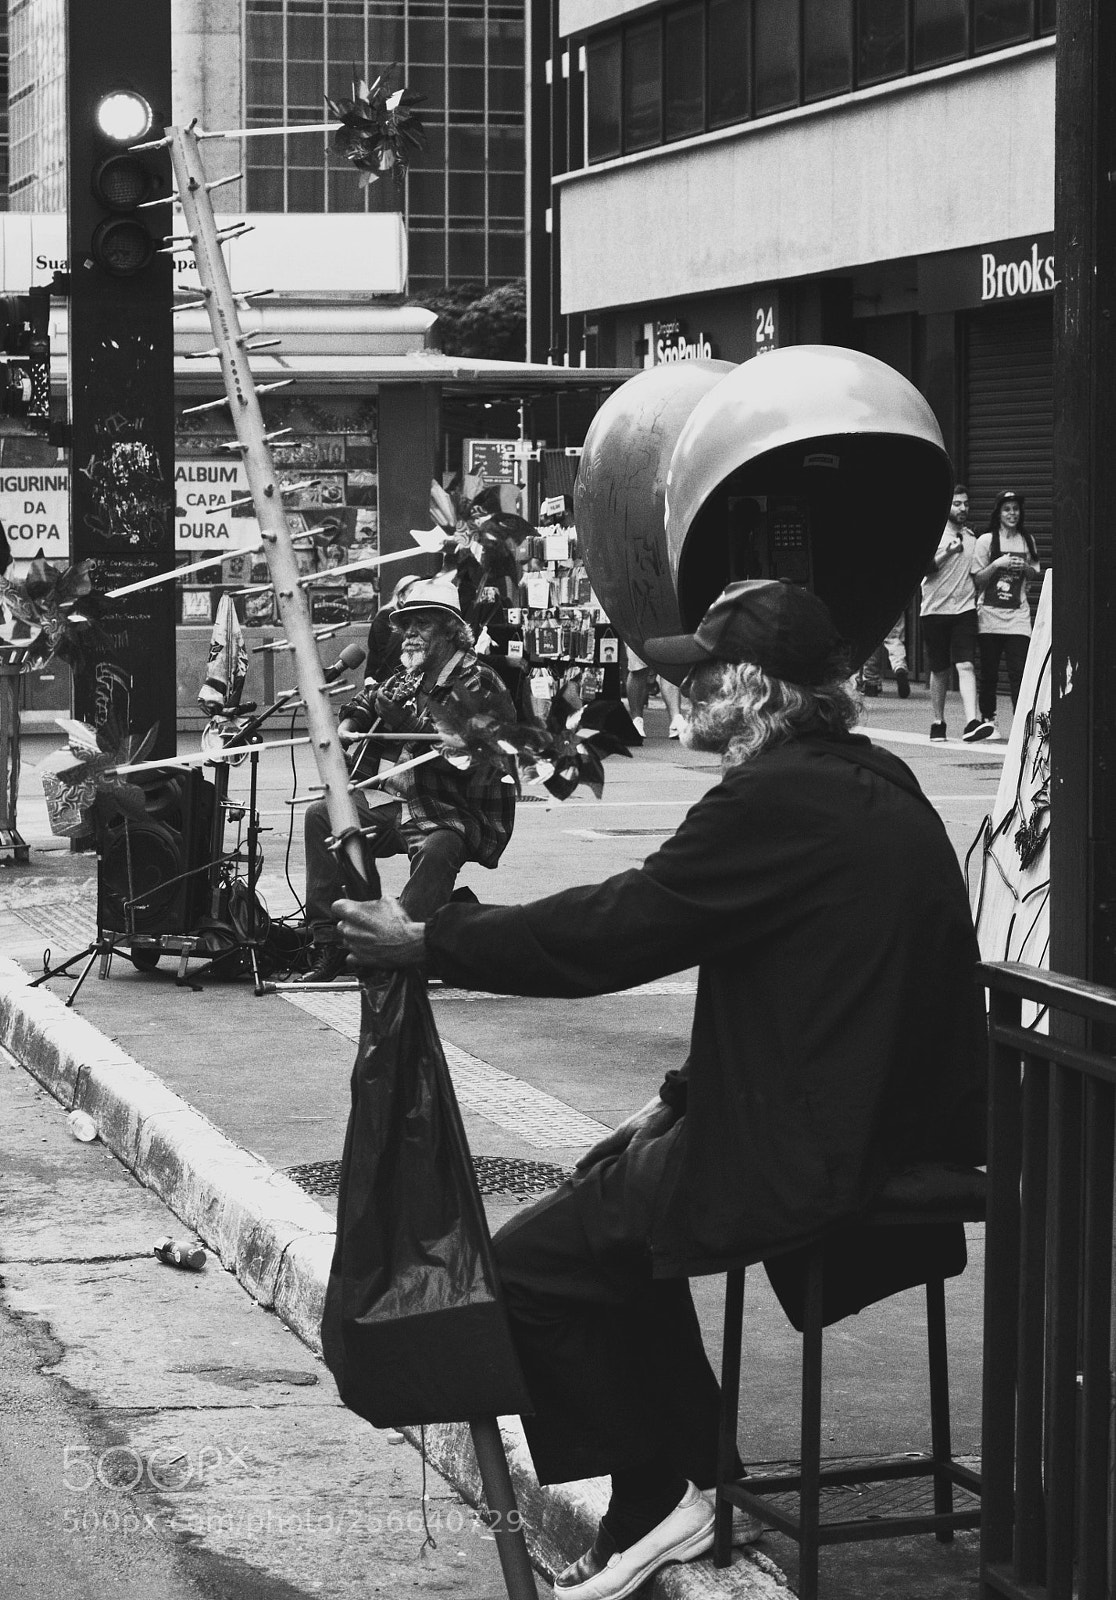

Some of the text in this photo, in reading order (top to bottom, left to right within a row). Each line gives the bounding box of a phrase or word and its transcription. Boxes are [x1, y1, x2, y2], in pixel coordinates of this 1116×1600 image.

[36, 255, 69, 270] Sua
[981, 243, 1055, 300] Brooks
[756, 306, 775, 343] 24
[175, 466, 238, 483] ALBUM
[24, 501, 47, 515] DA
[186, 493, 227, 507] CAPA
[7, 523, 61, 541] COPA
[179, 523, 230, 539] DURA
